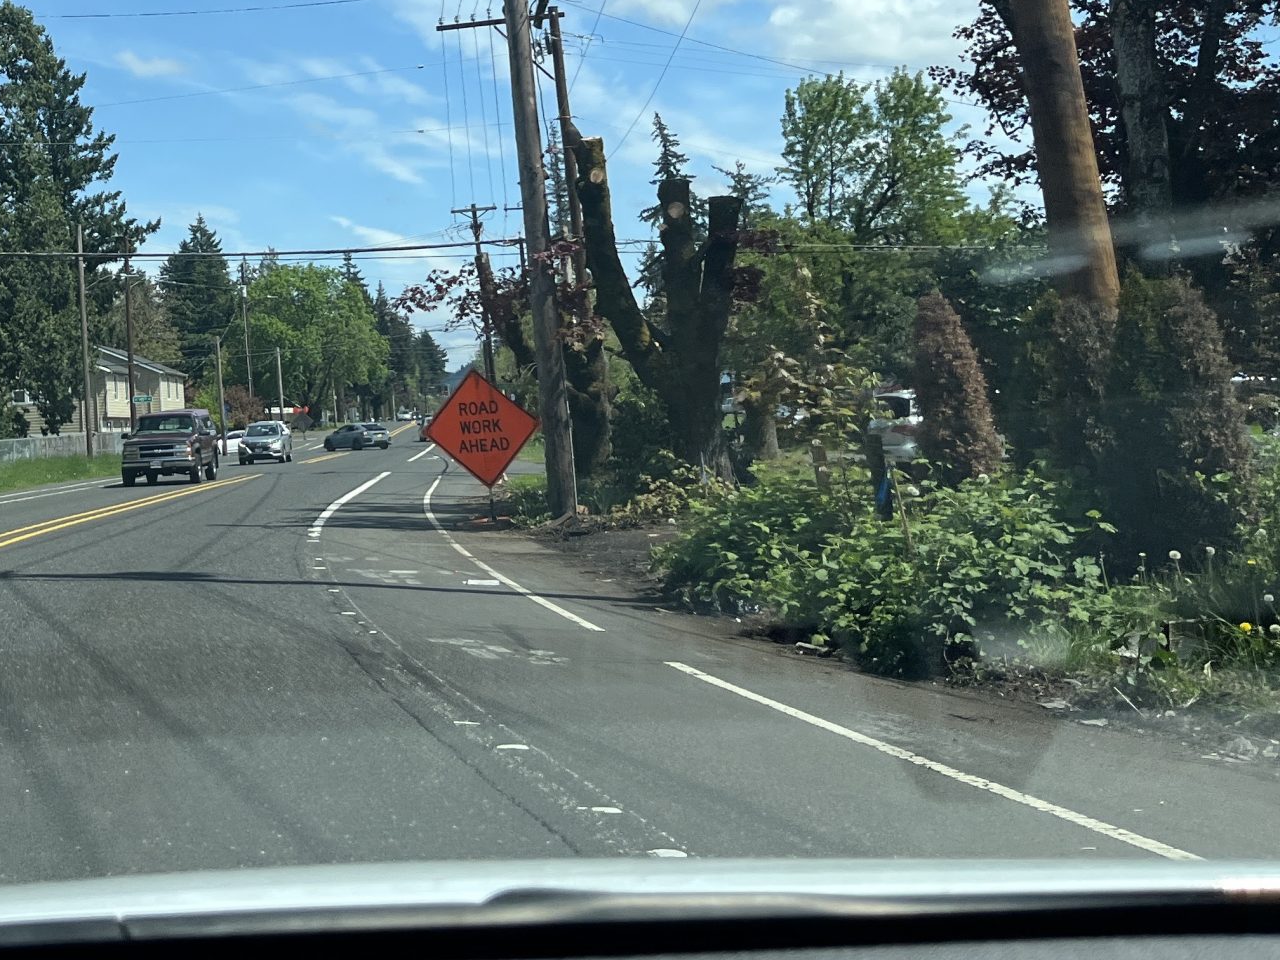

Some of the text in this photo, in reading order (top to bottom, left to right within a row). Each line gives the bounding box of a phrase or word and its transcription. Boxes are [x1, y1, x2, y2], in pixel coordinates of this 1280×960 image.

[458, 400, 498, 416] ROAD
[459, 419, 503, 435] WORK
[459, 436, 510, 453] AHEAD
